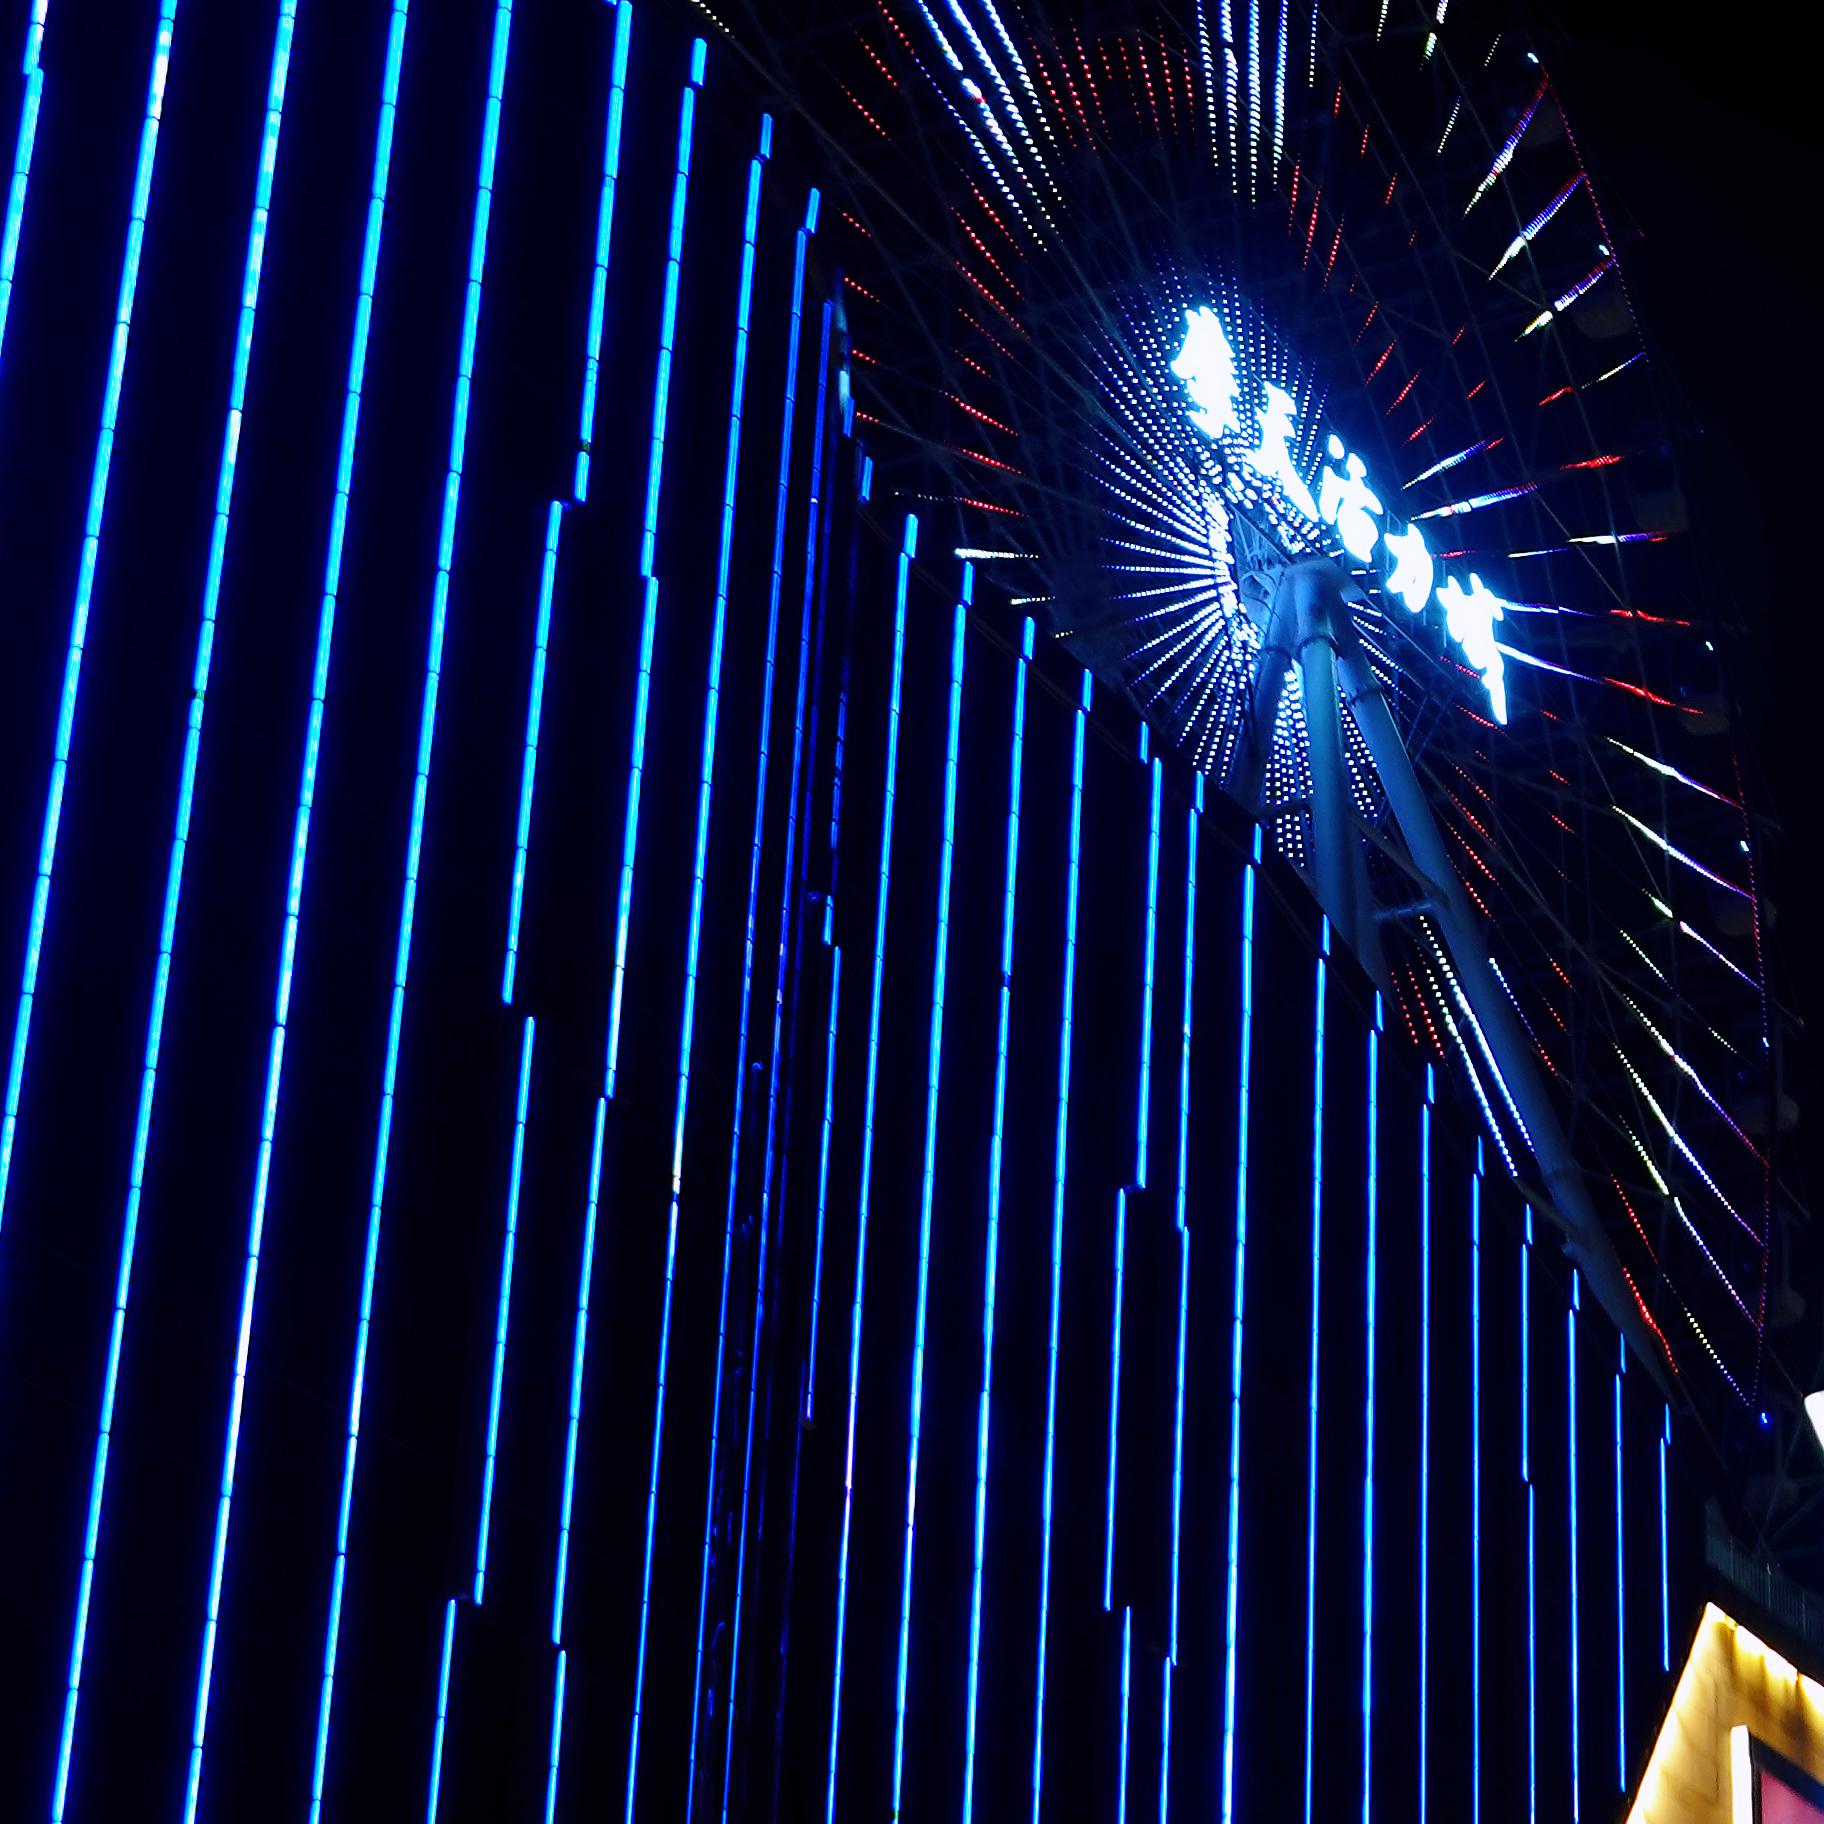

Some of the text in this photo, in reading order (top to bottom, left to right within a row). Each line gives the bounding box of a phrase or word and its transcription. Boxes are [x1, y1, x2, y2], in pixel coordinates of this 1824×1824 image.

[1171, 306, 1507, 724] 摩天活力城
